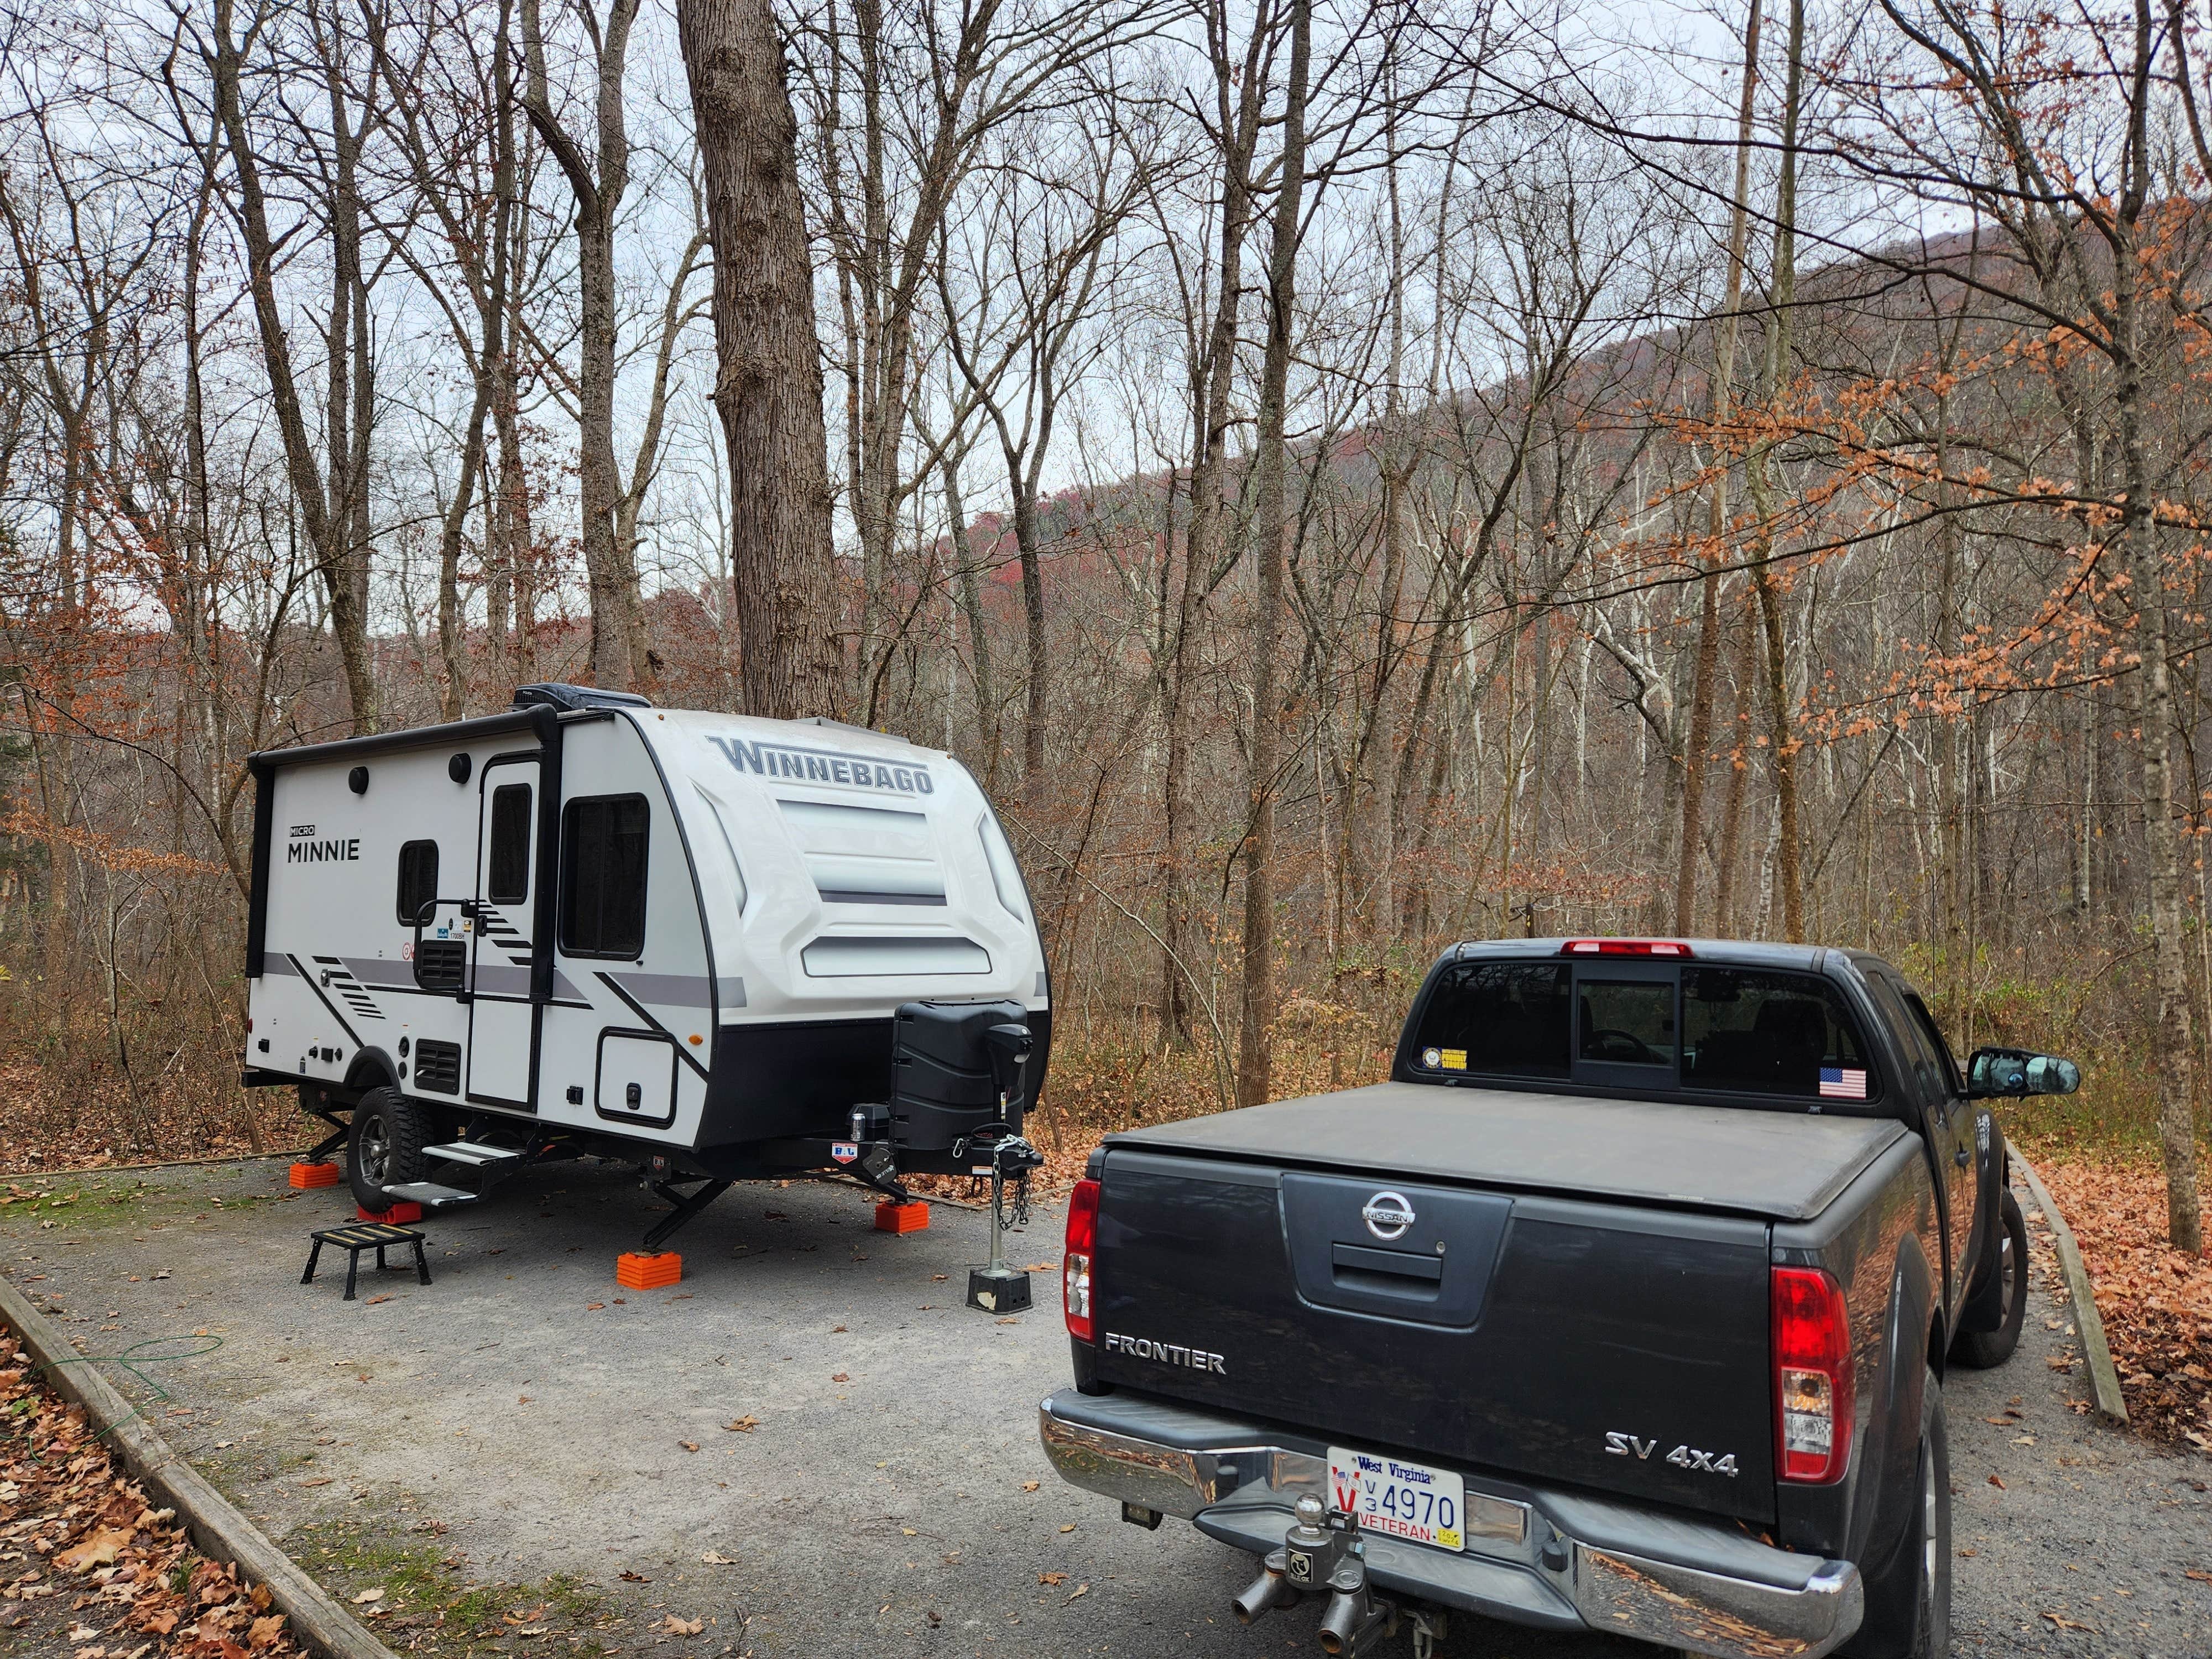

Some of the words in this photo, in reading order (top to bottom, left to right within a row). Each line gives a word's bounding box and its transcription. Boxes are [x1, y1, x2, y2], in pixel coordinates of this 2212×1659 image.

[704, 735, 935, 795] WINNEBAGO
[290, 826, 314, 836] MICRO
[288, 838, 360, 863] MINNIE
[1367, 1212, 1408, 1224] NISSAN
[1105, 1332, 1227, 1375] FRONTIER
[1605, 1431, 1657, 1460] SV
[1357, 1455, 1383, 1474] West
[1388, 1462, 1432, 1485] Virginia
[1365, 1479, 1376, 1494] V
[1365, 1498, 1376, 1512] 3
[1383, 1485, 1454, 1529] 4970
[1358, 1512, 1431, 1542] VETERAN
